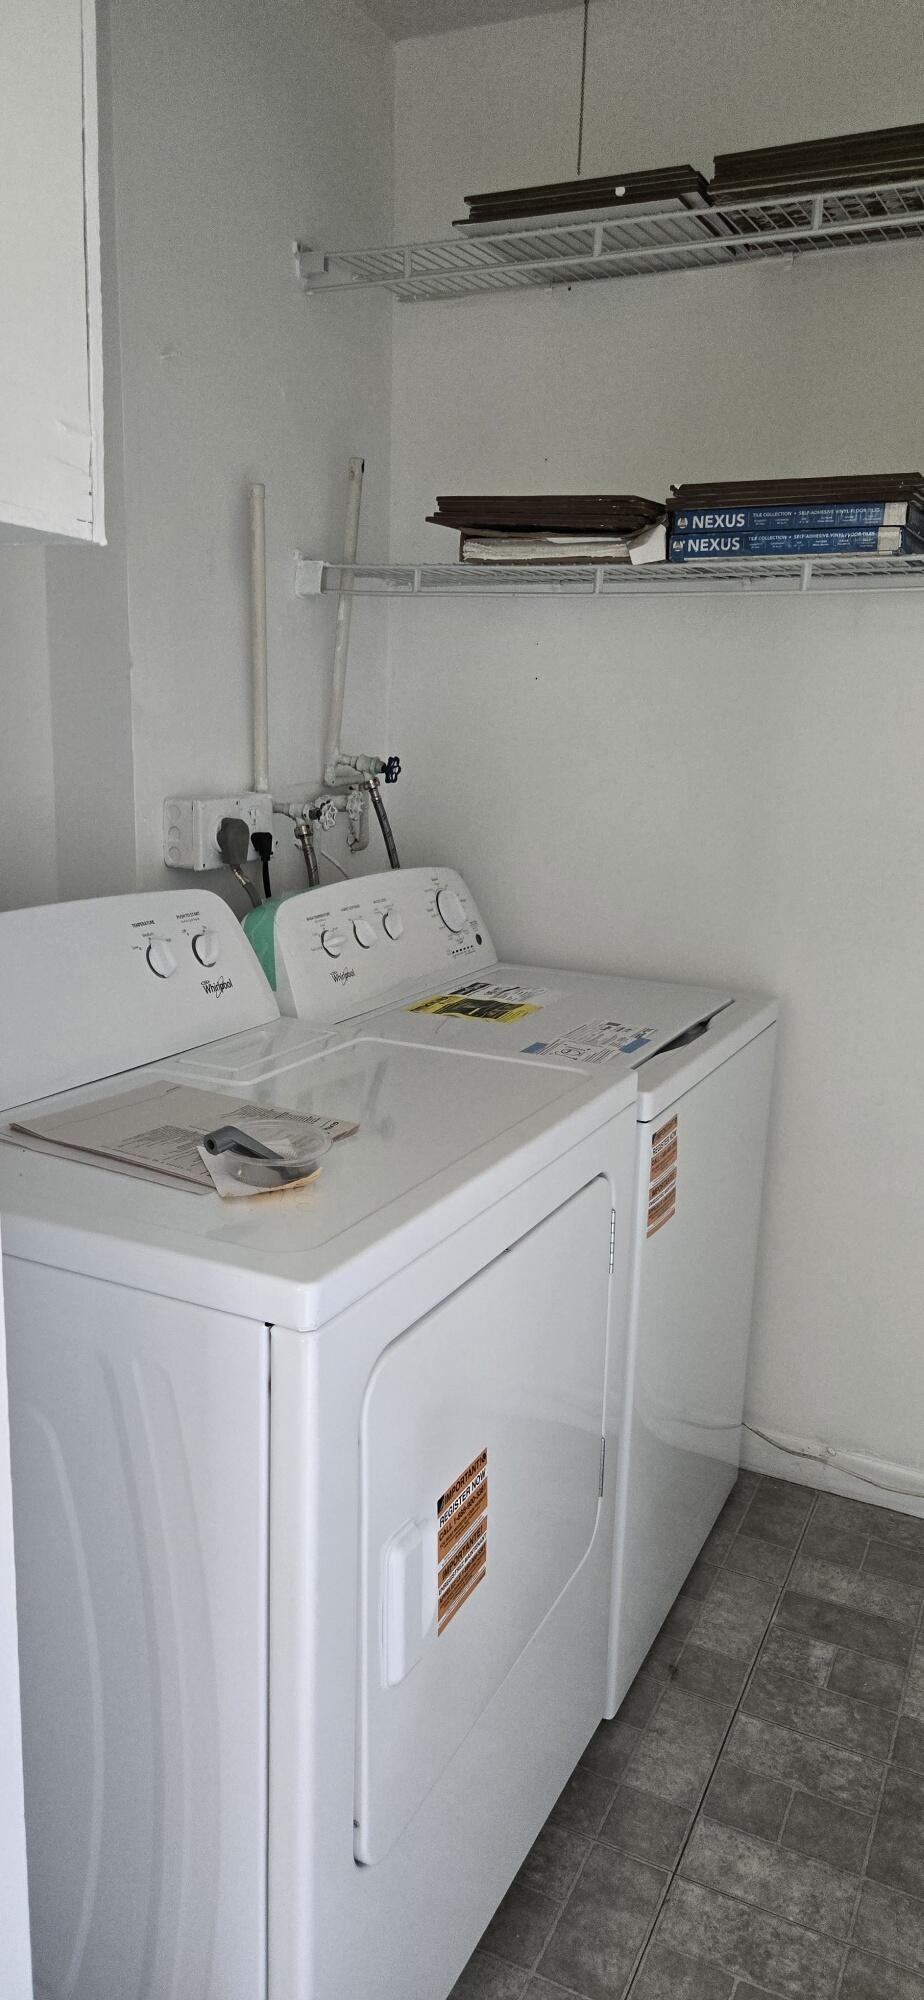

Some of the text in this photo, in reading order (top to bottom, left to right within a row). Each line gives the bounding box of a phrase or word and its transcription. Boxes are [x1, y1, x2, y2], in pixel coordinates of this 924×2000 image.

[692, 513, 745, 529] NEXUS
[687, 537, 740, 552] NEXUS
[330, 966, 356, 985] Whirlpool
[201, 976, 233, 998] Whirlpool
[440, 1486, 471, 1527] REGISTER
[471, 1468, 486, 1491] NOW
